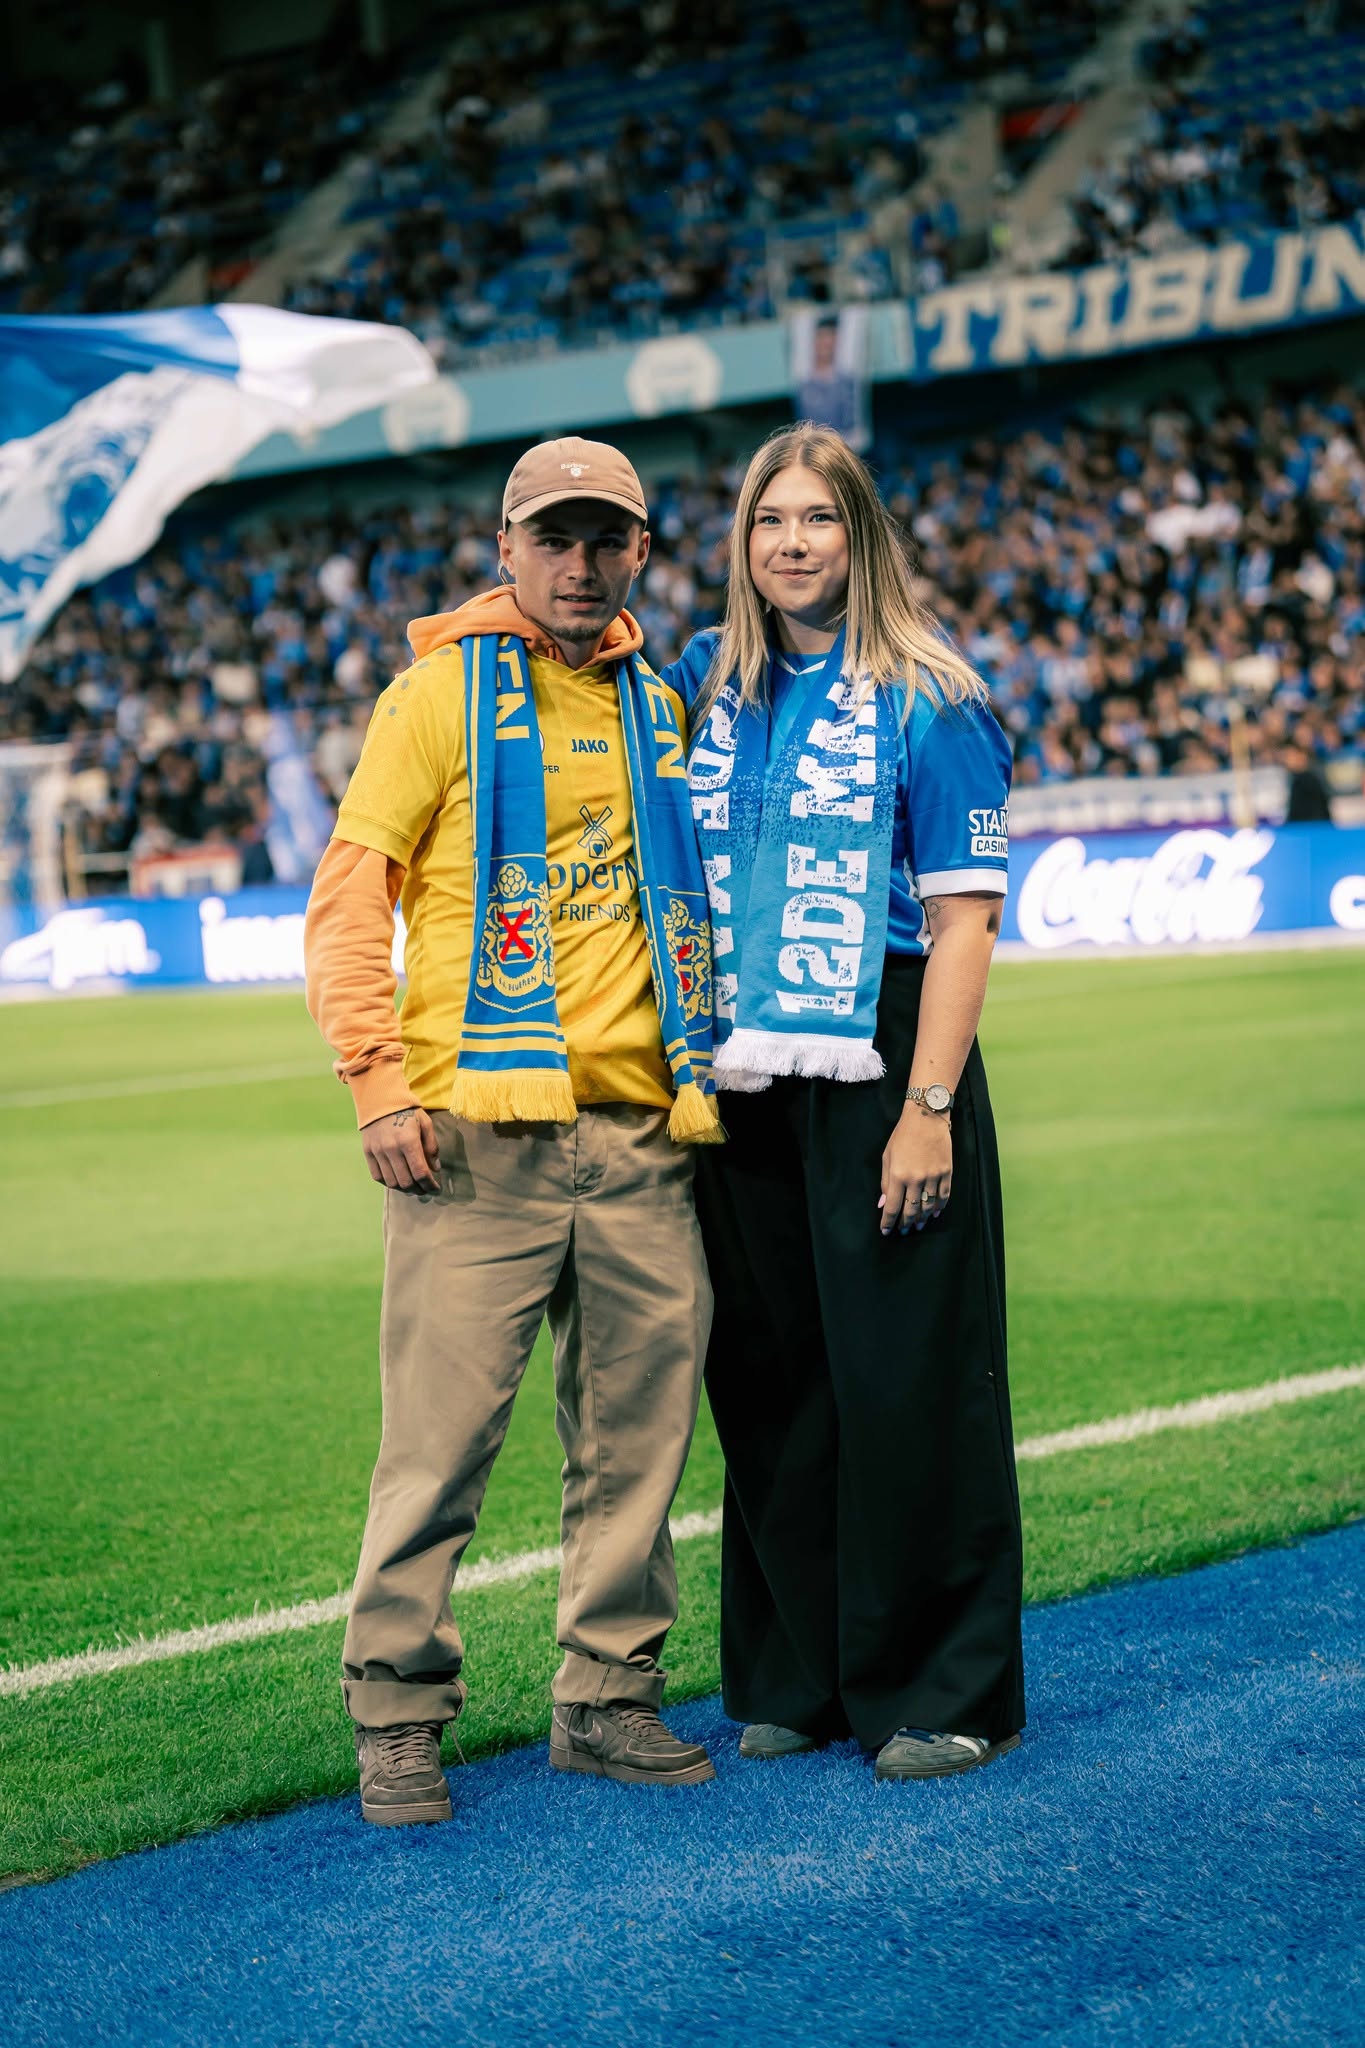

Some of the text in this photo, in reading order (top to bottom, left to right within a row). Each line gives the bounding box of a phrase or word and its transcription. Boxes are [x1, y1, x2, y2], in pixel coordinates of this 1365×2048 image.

[571, 738, 609, 754] JAKO
[558, 903, 630, 922] FRIENDS
[776, 843, 869, 1016] 12DE
